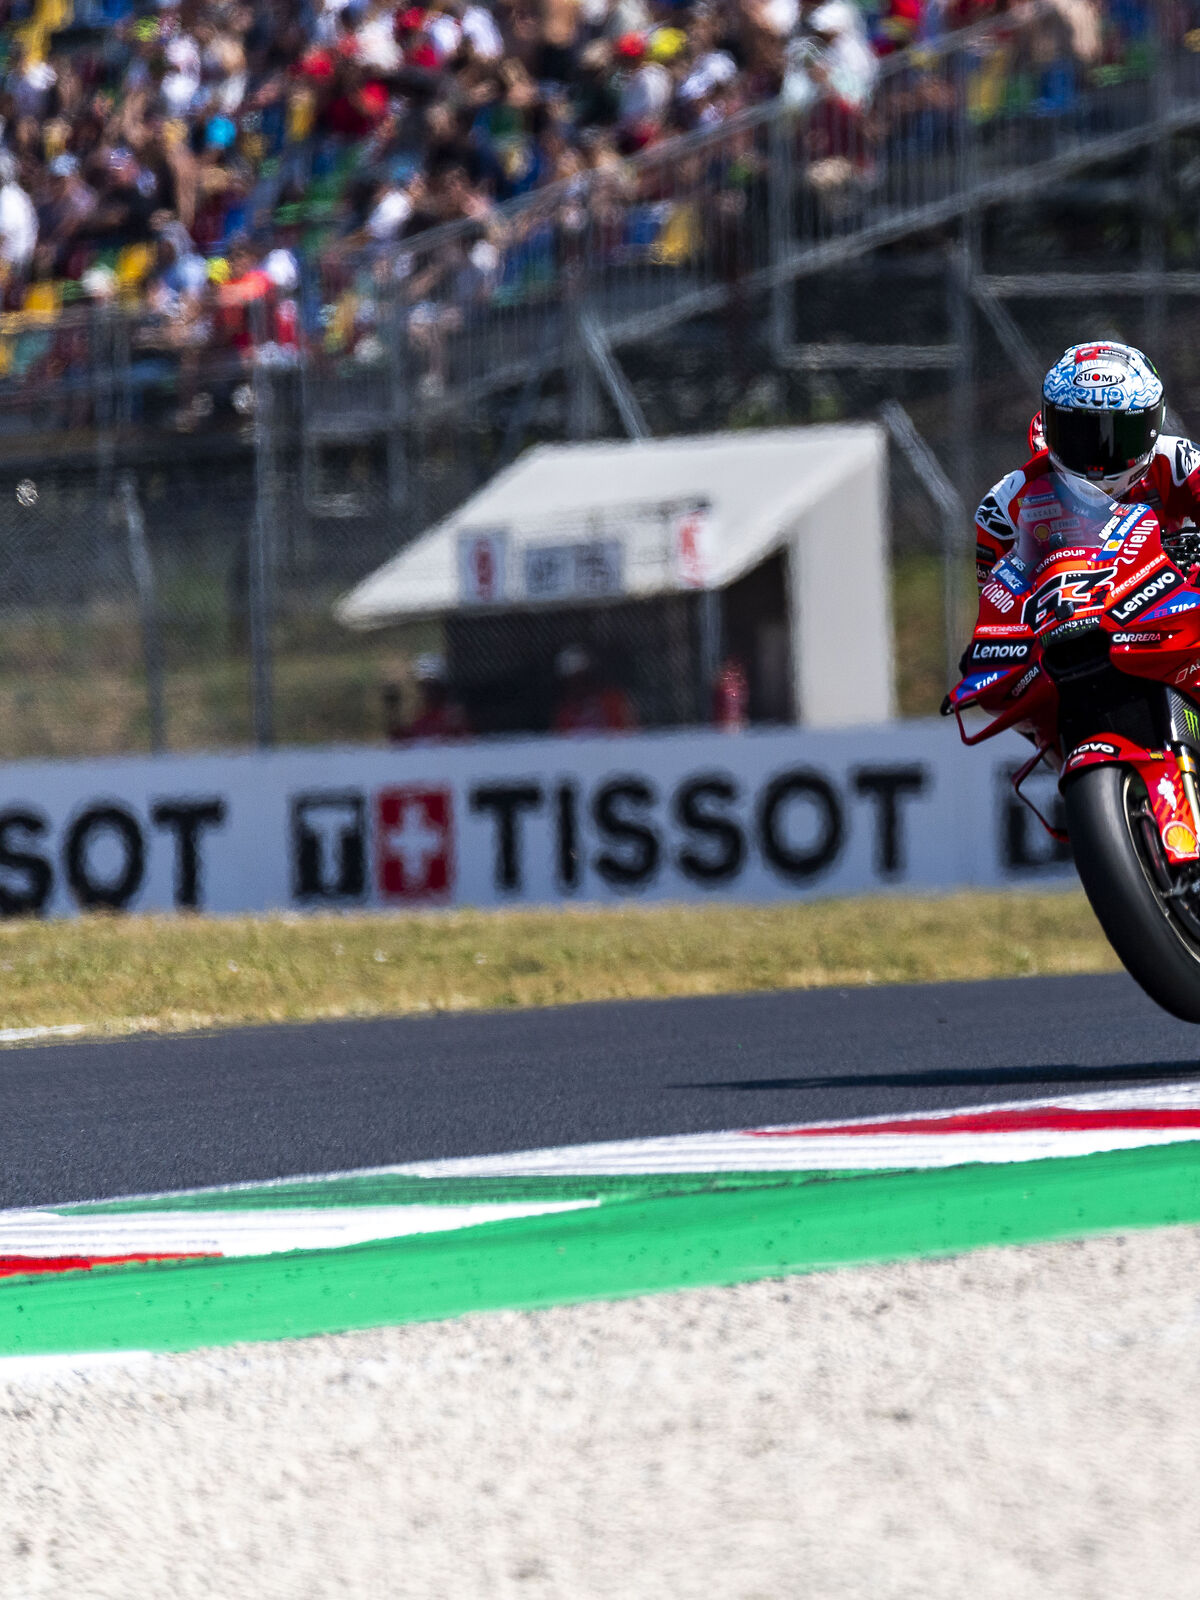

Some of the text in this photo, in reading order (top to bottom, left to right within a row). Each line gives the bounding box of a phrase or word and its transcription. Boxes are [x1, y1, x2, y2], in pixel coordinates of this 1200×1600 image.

[1123, 519, 1159, 556] riello
[983, 582, 1015, 614] riello
[1112, 572, 1176, 620] Lenovo
[1169, 602, 1197, 614] TIM
[1112, 633, 1161, 643] CARRERA
[972, 643, 1028, 659] Lenovo
[974, 672, 998, 690] TIM
[470, 762, 930, 891] TISSOT
